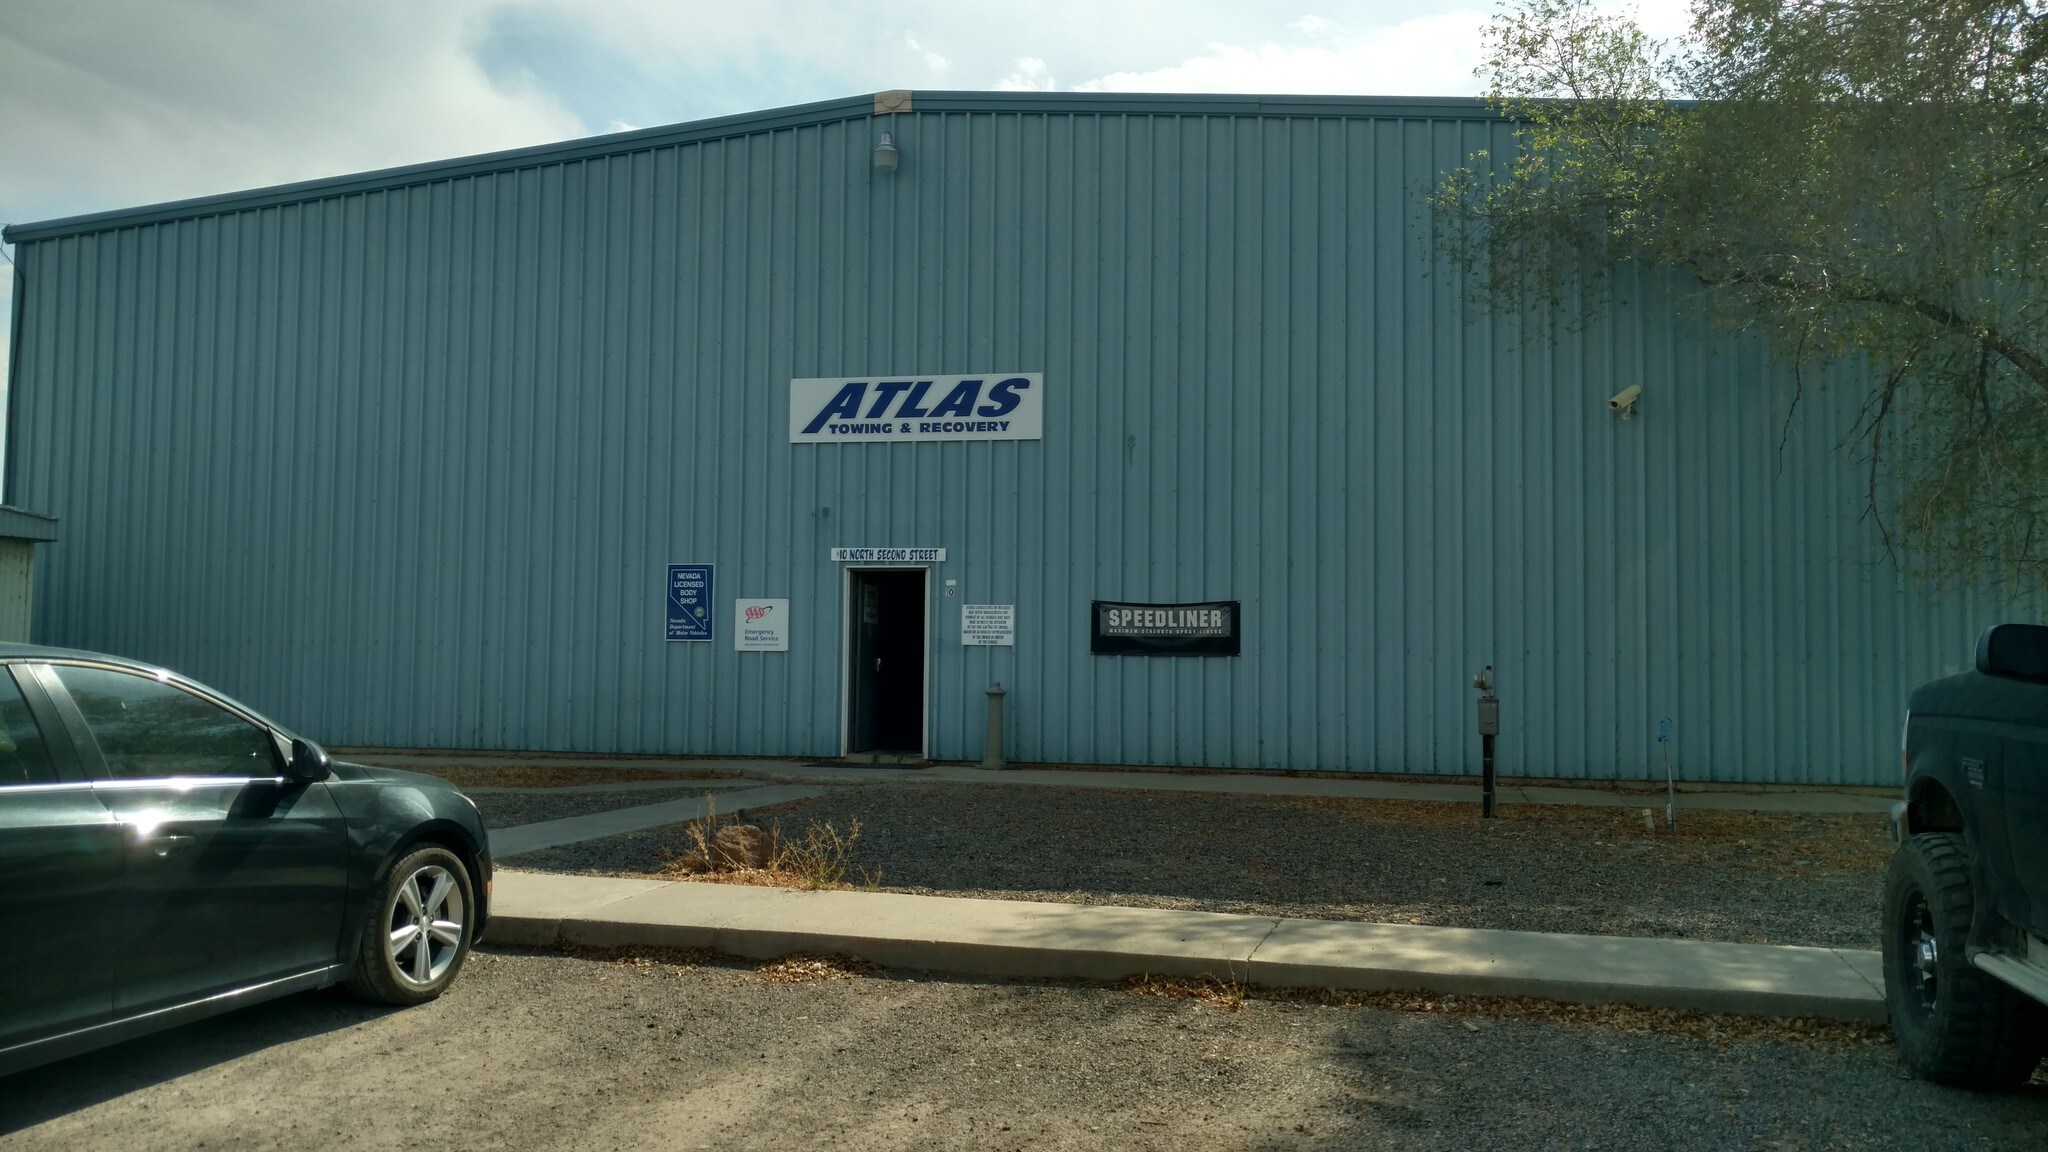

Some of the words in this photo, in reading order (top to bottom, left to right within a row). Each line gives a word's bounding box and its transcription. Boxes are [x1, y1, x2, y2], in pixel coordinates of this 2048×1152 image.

[801, 378, 1031, 434] ATLAS
[829, 423, 893, 434] TOWING
[900, 422, 911, 434] &
[920, 421, 1010, 433] RECOVERY
[850, 549, 874, 560] NORTH
[877, 549, 907, 560] SECOND
[909, 549, 938, 560] STREET
[1109, 609, 1222, 628] SPEEDLINER
